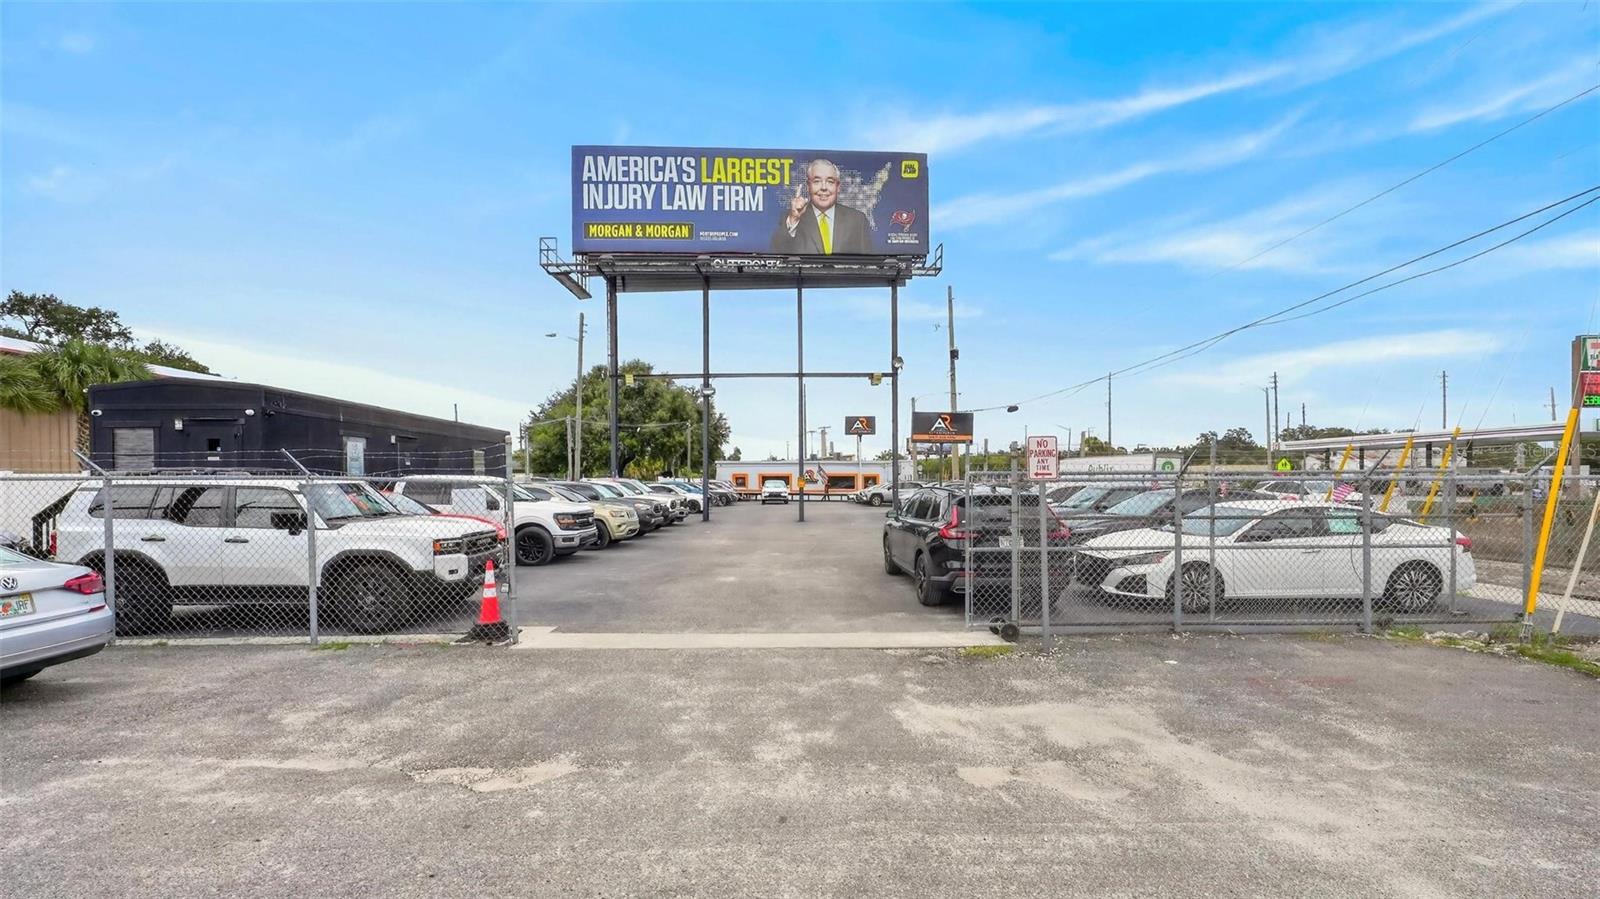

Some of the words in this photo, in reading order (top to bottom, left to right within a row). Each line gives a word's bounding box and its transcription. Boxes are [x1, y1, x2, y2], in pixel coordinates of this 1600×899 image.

[583, 155, 695, 183] AMERICA'S
[701, 157, 793, 185] LARGEST
[583, 184, 656, 210] INJURY
[662, 184, 708, 211] LAW
[712, 185, 763, 211] FIRM
[589, 225, 632, 237] MORGAN
[635, 225, 642, 237] &
[646, 225, 689, 238] MORGAN
[1036, 440, 1048, 448] NO
[1030, 449, 1056, 457] PARKING
